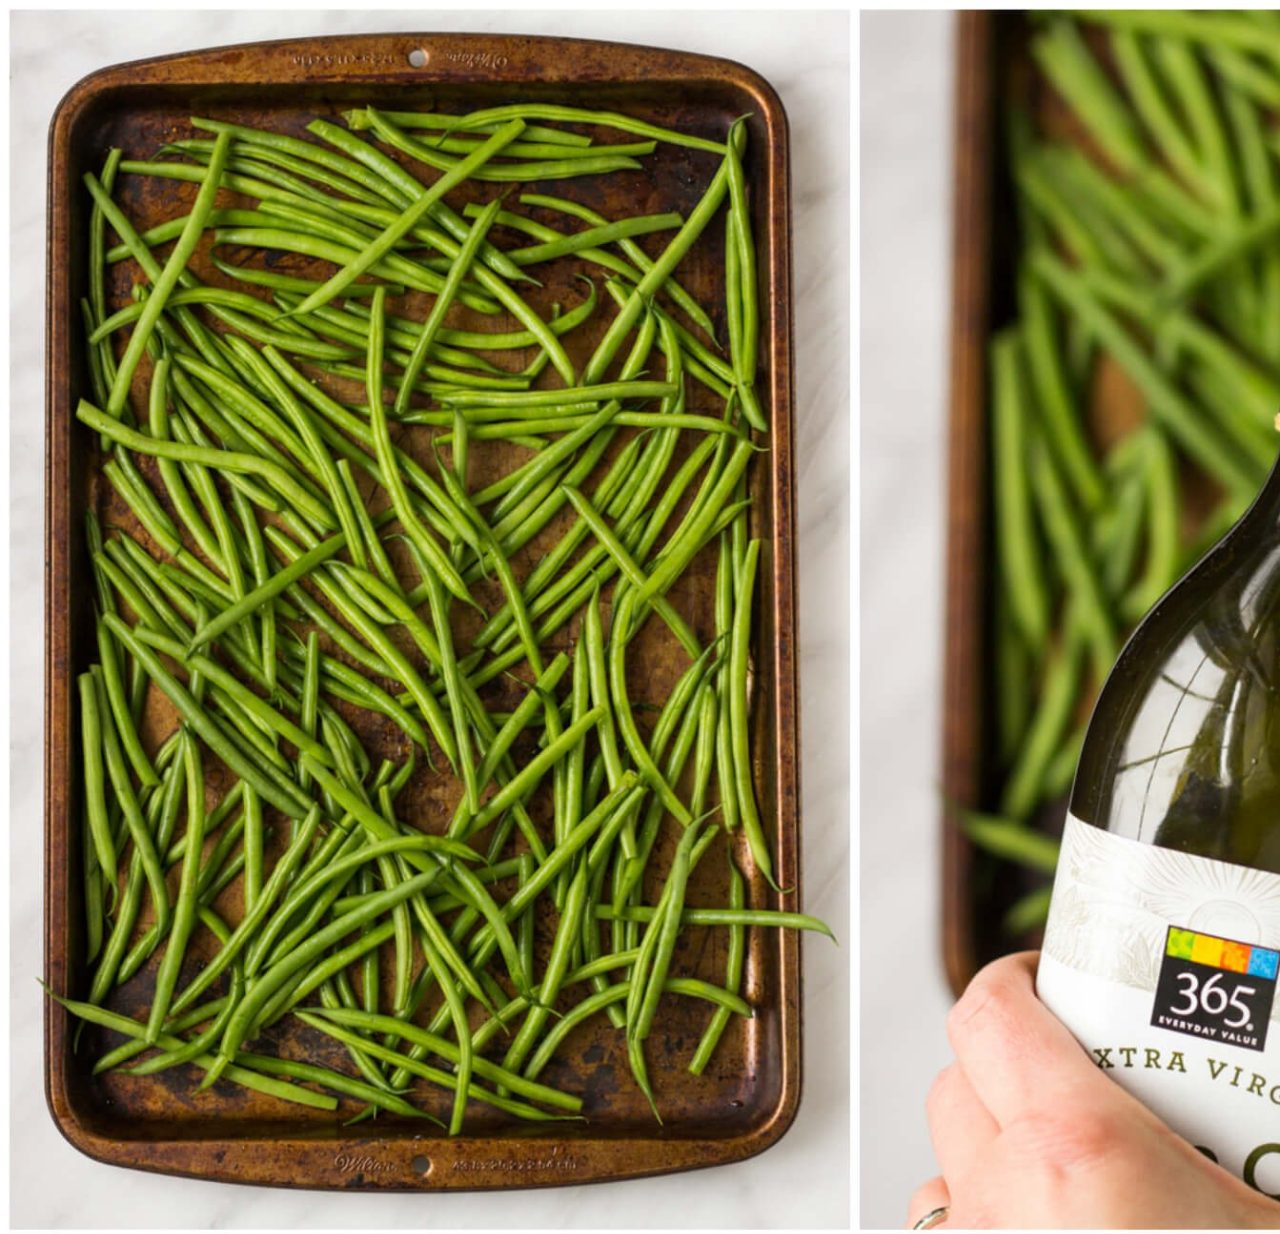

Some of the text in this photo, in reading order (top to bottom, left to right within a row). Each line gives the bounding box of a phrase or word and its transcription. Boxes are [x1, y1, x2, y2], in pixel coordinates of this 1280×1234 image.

[1158, 1015, 1258, 1046] EVERYDAY VALUE
[1093, 1048, 1188, 1073] XTRA
